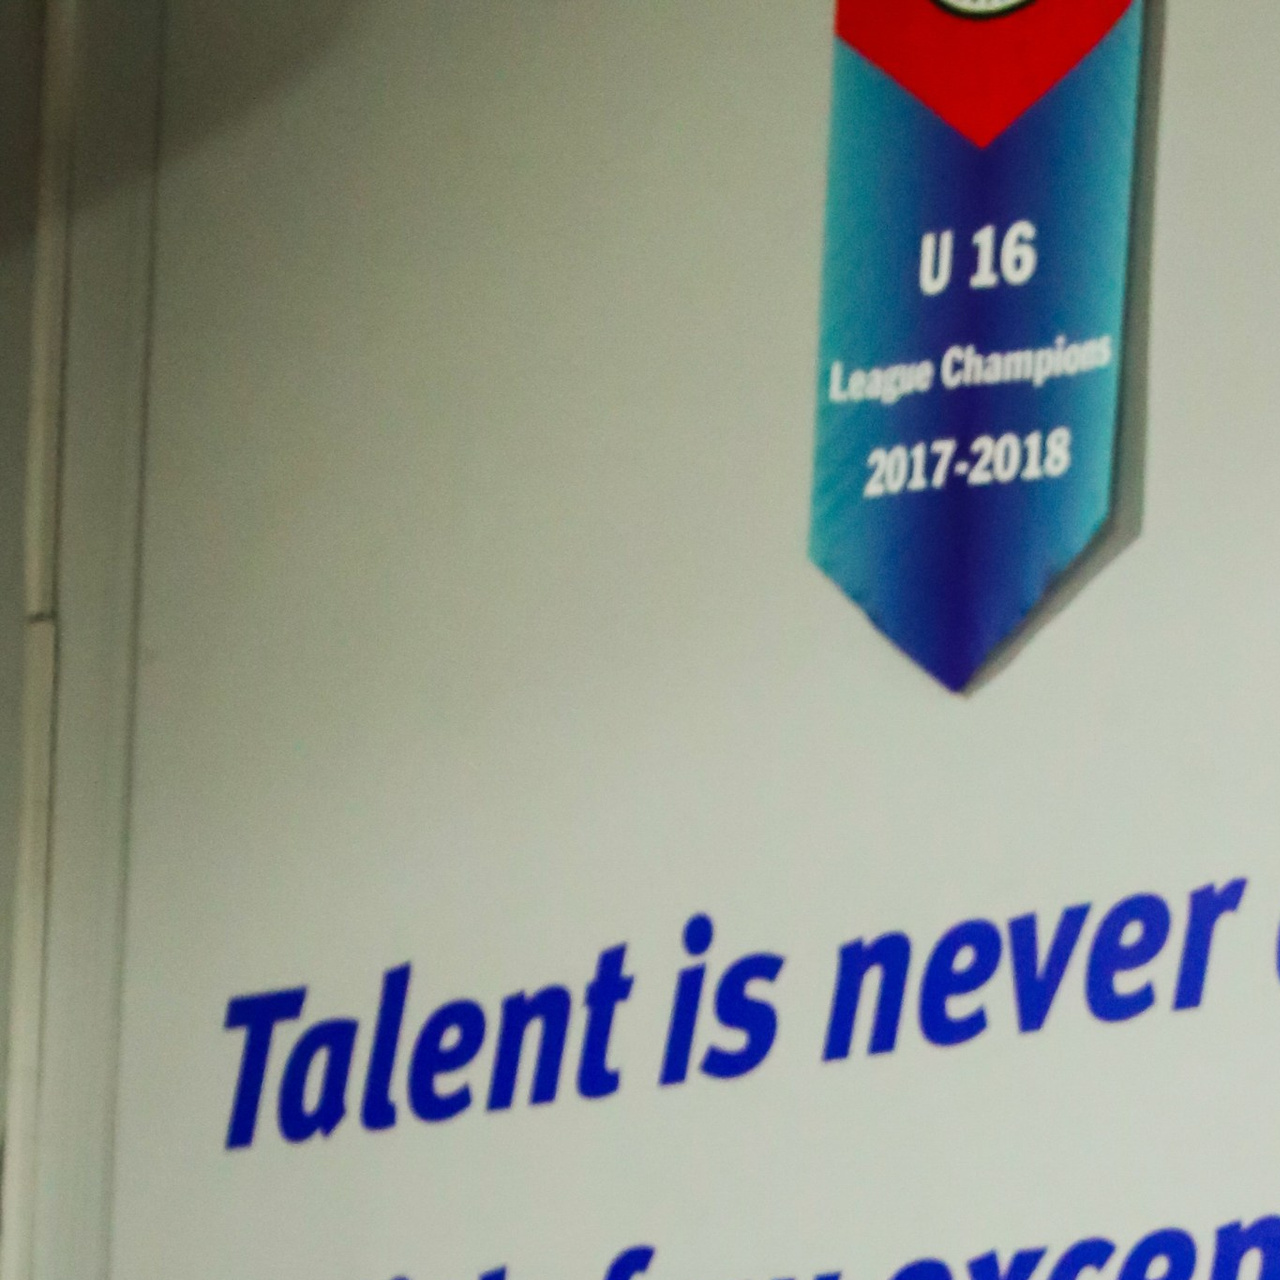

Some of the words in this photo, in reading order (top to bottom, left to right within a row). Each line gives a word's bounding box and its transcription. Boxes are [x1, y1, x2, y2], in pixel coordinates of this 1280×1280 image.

[918, 229, 953, 296] U
[969, 219, 1038, 288] 16
[828, 360, 933, 404] League
[940, 334, 1114, 389] Champions
[863, 425, 1072, 498] 2017-2018
[223, 943, 635, 1150] Talent
[658, 912, 785, 1087] is
[822, 876, 1248, 1064] never
